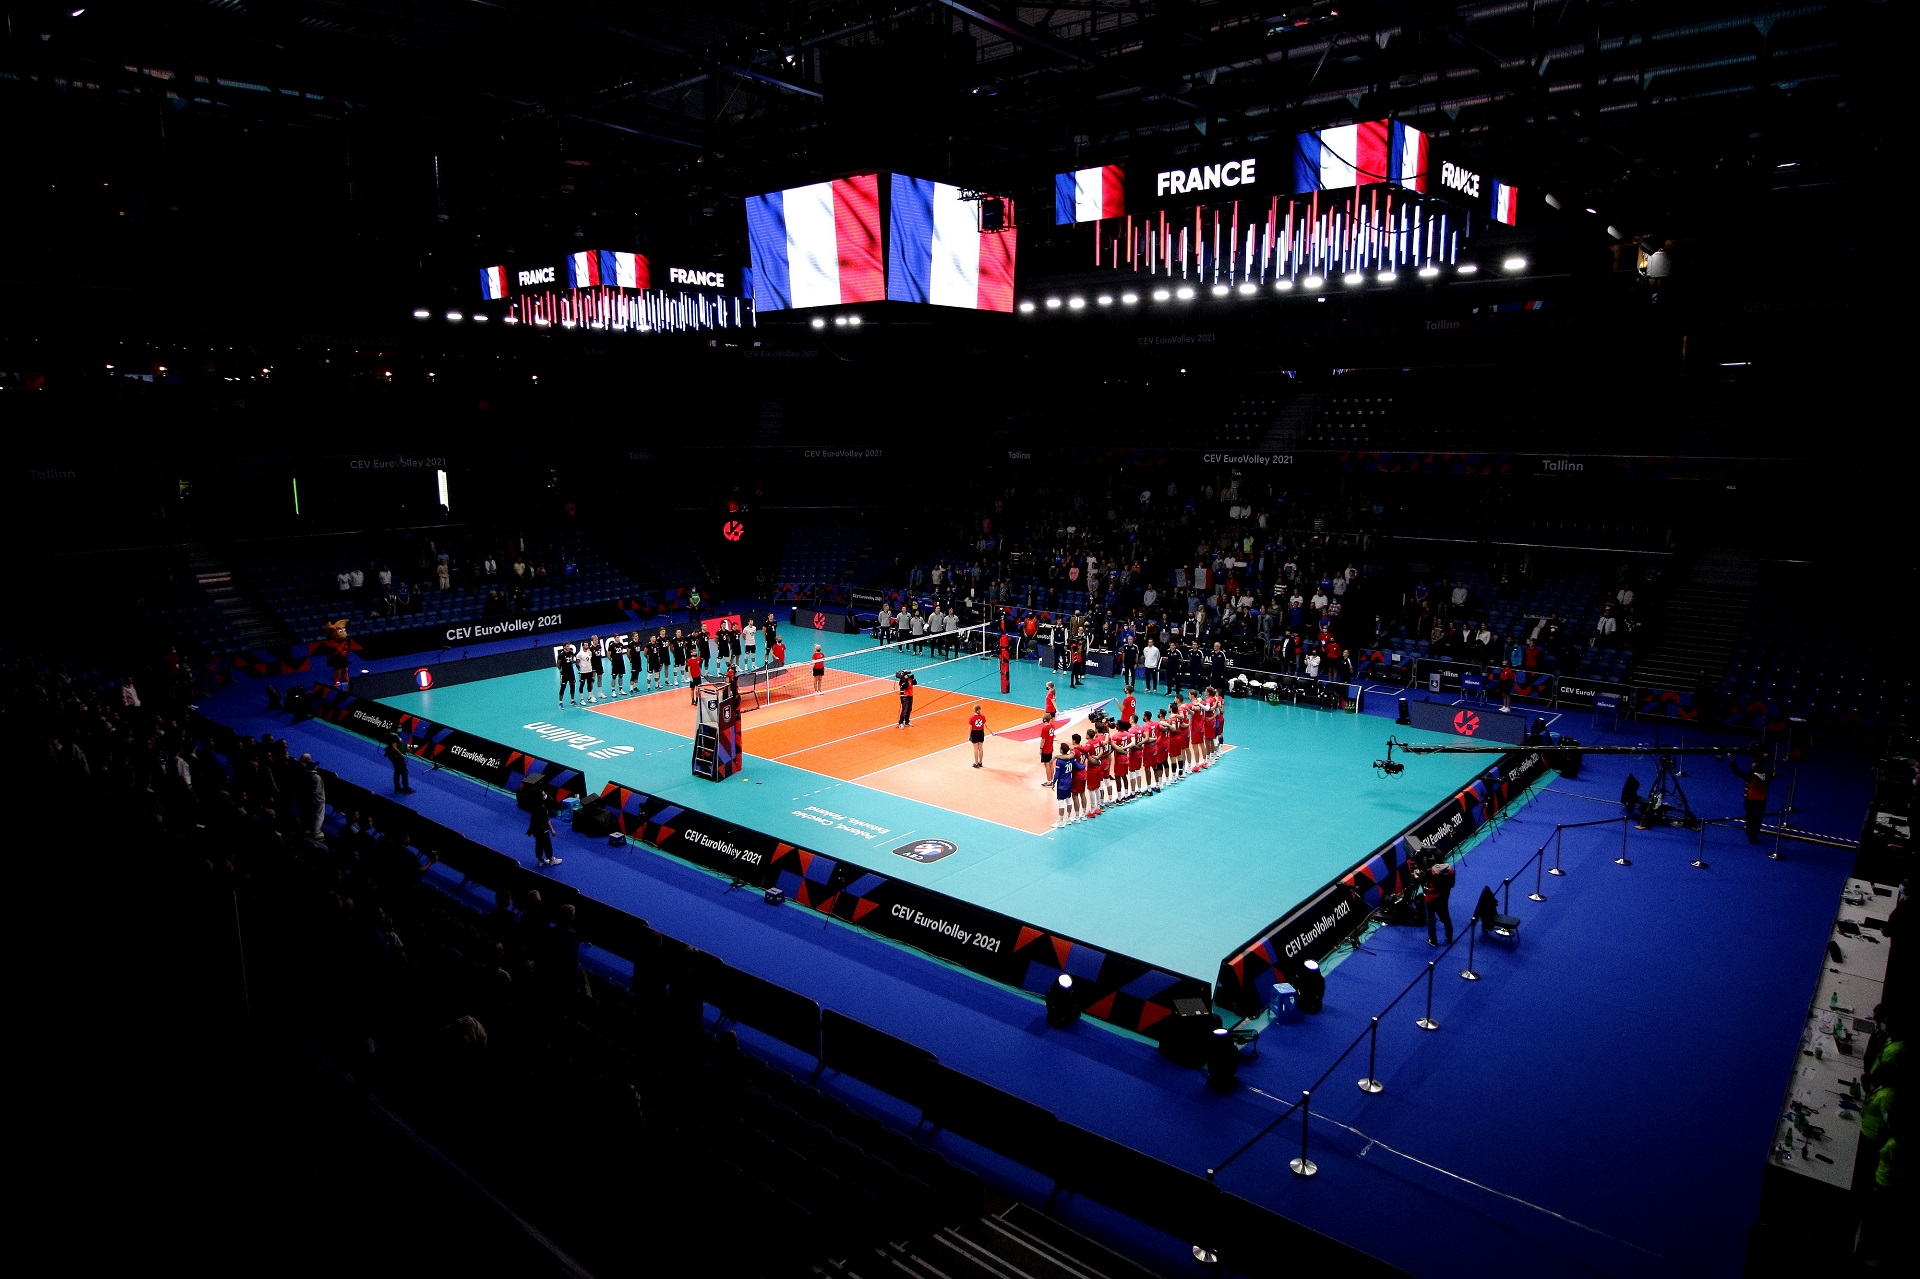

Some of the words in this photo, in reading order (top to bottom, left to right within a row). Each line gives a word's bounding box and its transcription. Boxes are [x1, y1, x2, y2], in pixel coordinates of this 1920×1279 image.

[1158, 159, 1255, 196] FRANCE
[1441, 160, 1480, 198] FRANCE
[519, 267, 555, 286] FRANCE
[670, 267, 725, 288] FRANCE
[1425, 319, 1460, 330] Tallinn
[1138, 337, 1154, 345] CEV
[1156, 333, 1195, 345] EuroVolley
[804, 449, 821, 458] CEV
[823, 449, 863, 459] EuroVolley
[1203, 454, 1222, 463] CEV
[1224, 454, 1271, 467] EuroVolley
[1272, 455, 1293, 465] 2021
[350, 460, 371, 469] CEV
[425, 457, 446, 467] 2021
[1542, 459, 1584, 472] Tallinn
[446, 627, 473, 641] CEV
[474, 619, 535, 638] EuroVolley
[537, 614, 562, 628] 2021
[1560, 686, 1575, 694] CEV
[523, 721, 606, 751] Tallinn
[451, 745, 463, 756] CEV
[461, 747, 487, 765] EuroVolley
[1064, 762, 1073, 774] 20
[791, 810, 835, 826] Czechia
[804, 805, 848, 821] Finland
[684, 828, 702, 843] CEV
[740, 849, 763, 866] 2021
[891, 903, 916, 921] CEV
[913, 911, 973, 945] EuroVolley
[972, 932, 1001, 953] 2021
[1285, 936, 1302, 958] CEV
[1300, 914, 1336, 947] EuroVolley
[1333, 900, 1351, 921] 2021
